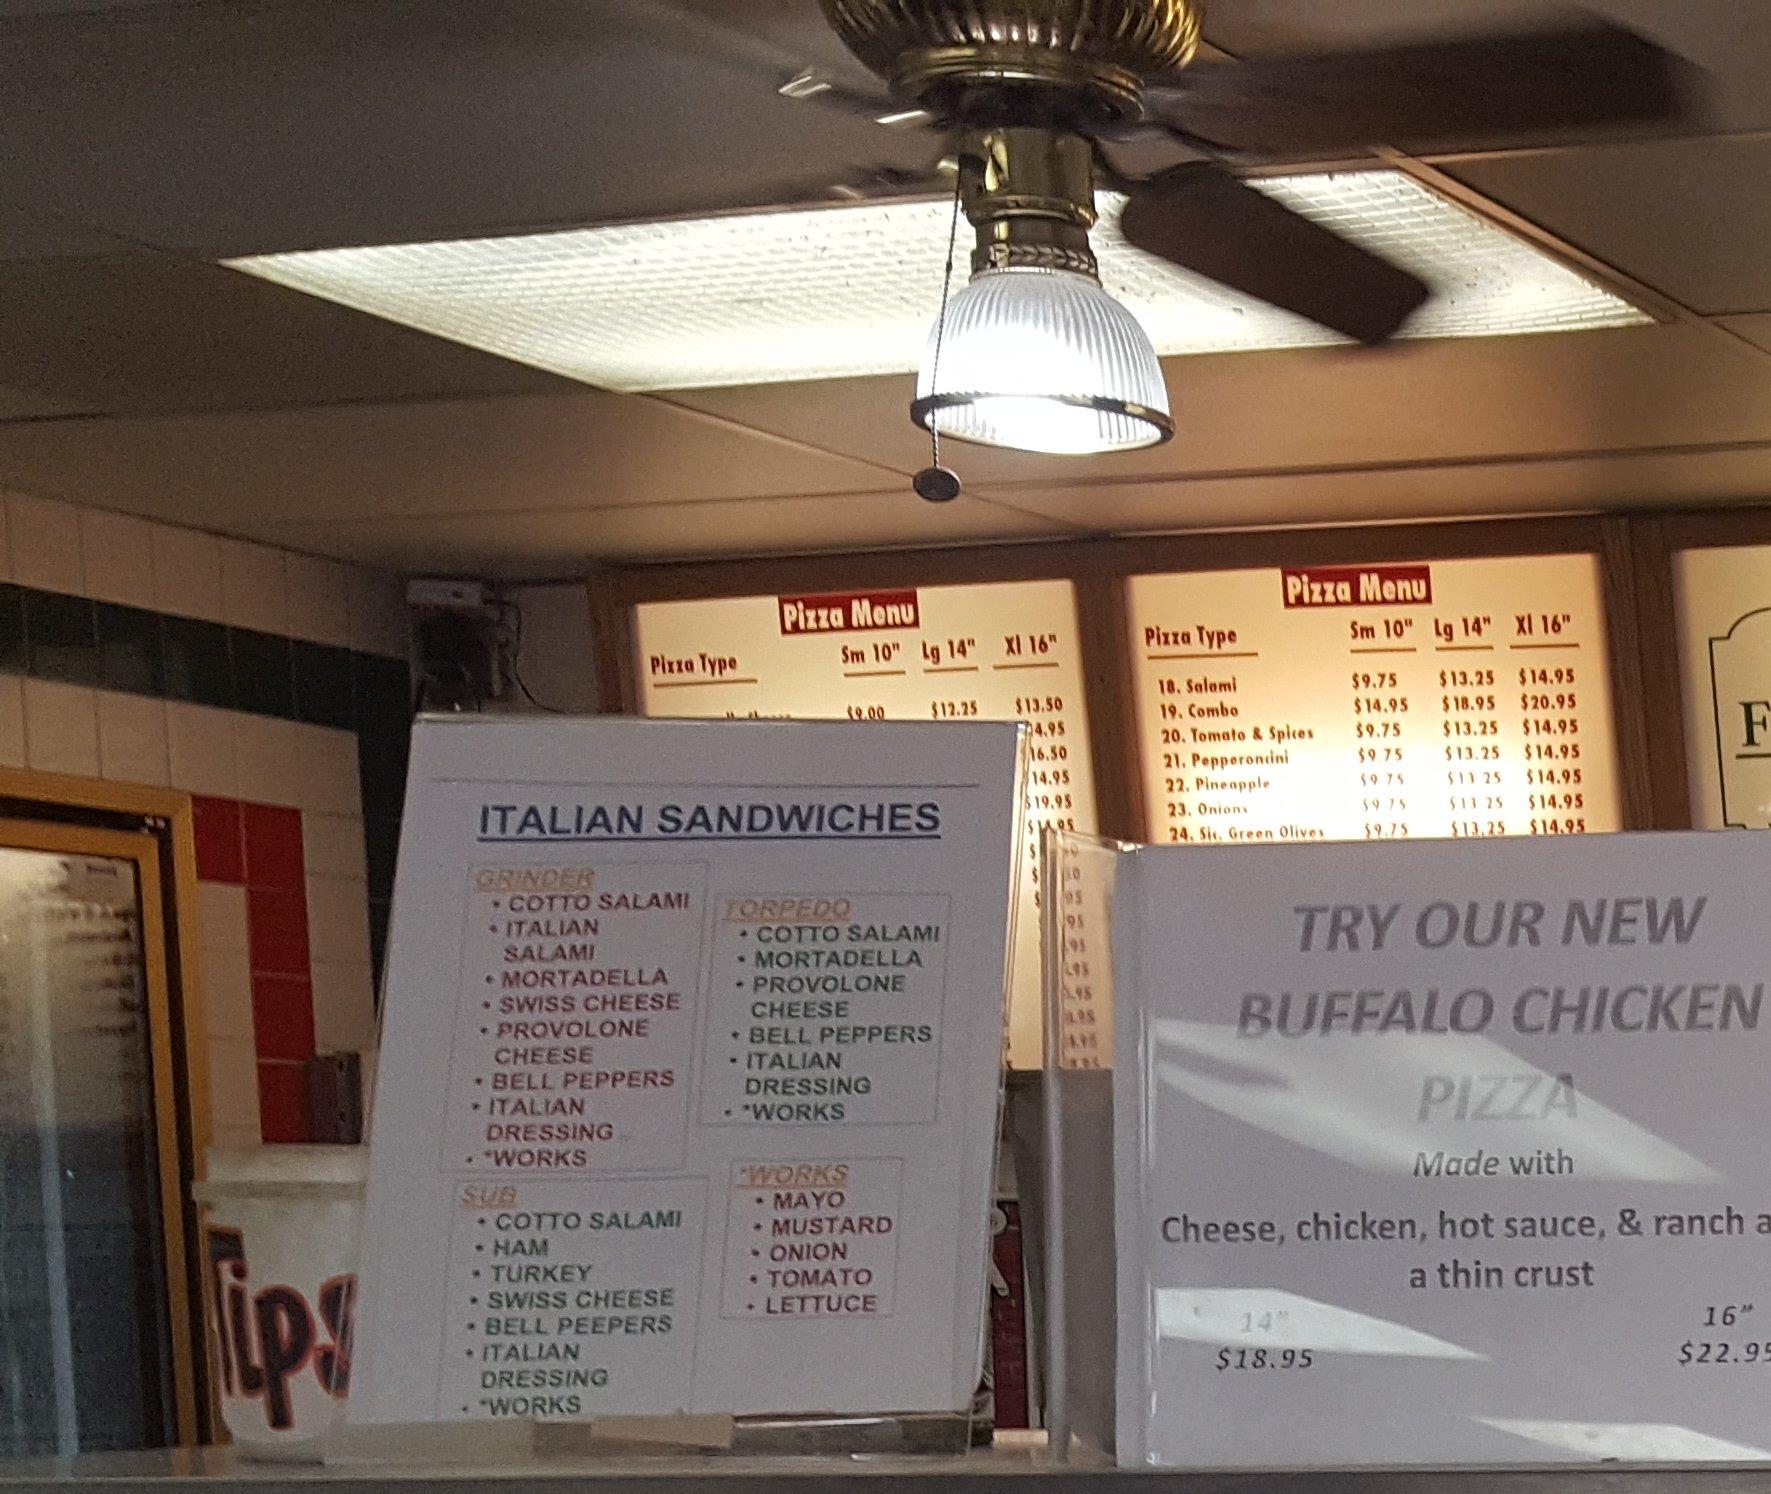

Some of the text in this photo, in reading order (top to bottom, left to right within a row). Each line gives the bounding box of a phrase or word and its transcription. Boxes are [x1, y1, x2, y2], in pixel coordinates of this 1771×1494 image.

[1286, 573, 1427, 605] Pizza Menu
[783, 598, 916, 633] Pizza Menu
[651, 634, 1057, 677] Pizza Type Sm 10" Lg 14" Xl 16"
[1159, 668, 1574, 695] 18. Salami $9.75 $13.25 $14.95
[478, 801, 941, 835] ITALIAN SANDWICHES
[476, 869, 592, 890] GRINDER
[510, 892, 689, 913] COTTO SALAMI
[725, 899, 851, 919] TORPEDO
[1294, 896, 1707, 952] TRY OUR NEW
[1237, 983, 1763, 1039] BUFFALO CHICKEN
[1417, 1072, 1579, 1123] PIZZA
[1413, 1149, 1573, 1179] Made with
[460, 1185, 516, 1205] SUB
[772, 1216, 892, 1237] MUSTARD
[1162, 1214, 1285, 1246] Cheese,
[1297, 1211, 1426, 1242] chicken,
[1439, 1210, 1494, 1239] hot
[1505, 1216, 1605, 1240] sauce,
[1617, 1209, 1643, 1236] &
[1654, 1206, 1744, 1235] ranch
[768, 1269, 872, 1287] TOMATO
[1410, 1259, 1594, 1289] a thin crust
[485, 1315, 672, 1335] BELL PEEPERS
[1704, 1304, 1753, 1326] 16"
[1216, 1347, 1314, 1371] $18.95
